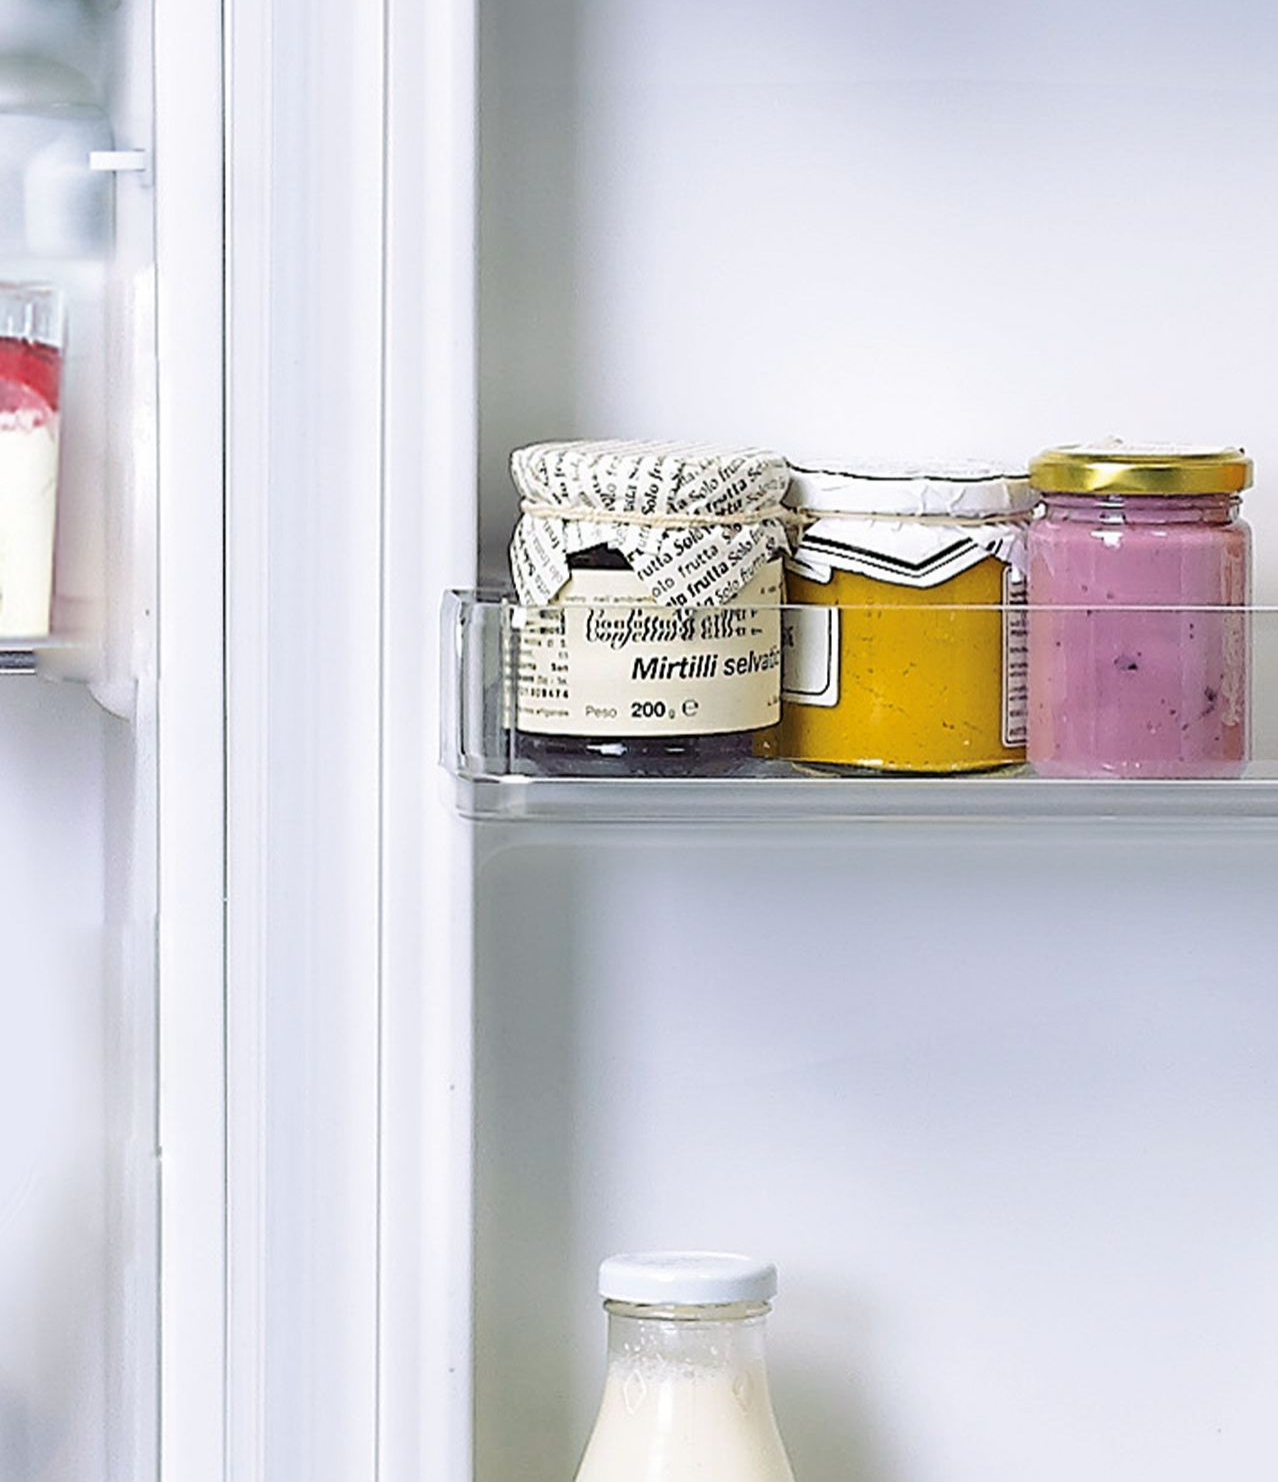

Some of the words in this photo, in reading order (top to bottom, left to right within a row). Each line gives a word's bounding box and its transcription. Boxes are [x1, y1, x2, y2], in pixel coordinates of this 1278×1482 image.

[677, 543, 720, 579] frutta
[686, 560, 730, 598] frutta
[631, 654, 719, 680] Mirtilli
[585, 704, 619, 719] Peso
[631, 700, 667, 718] 200
